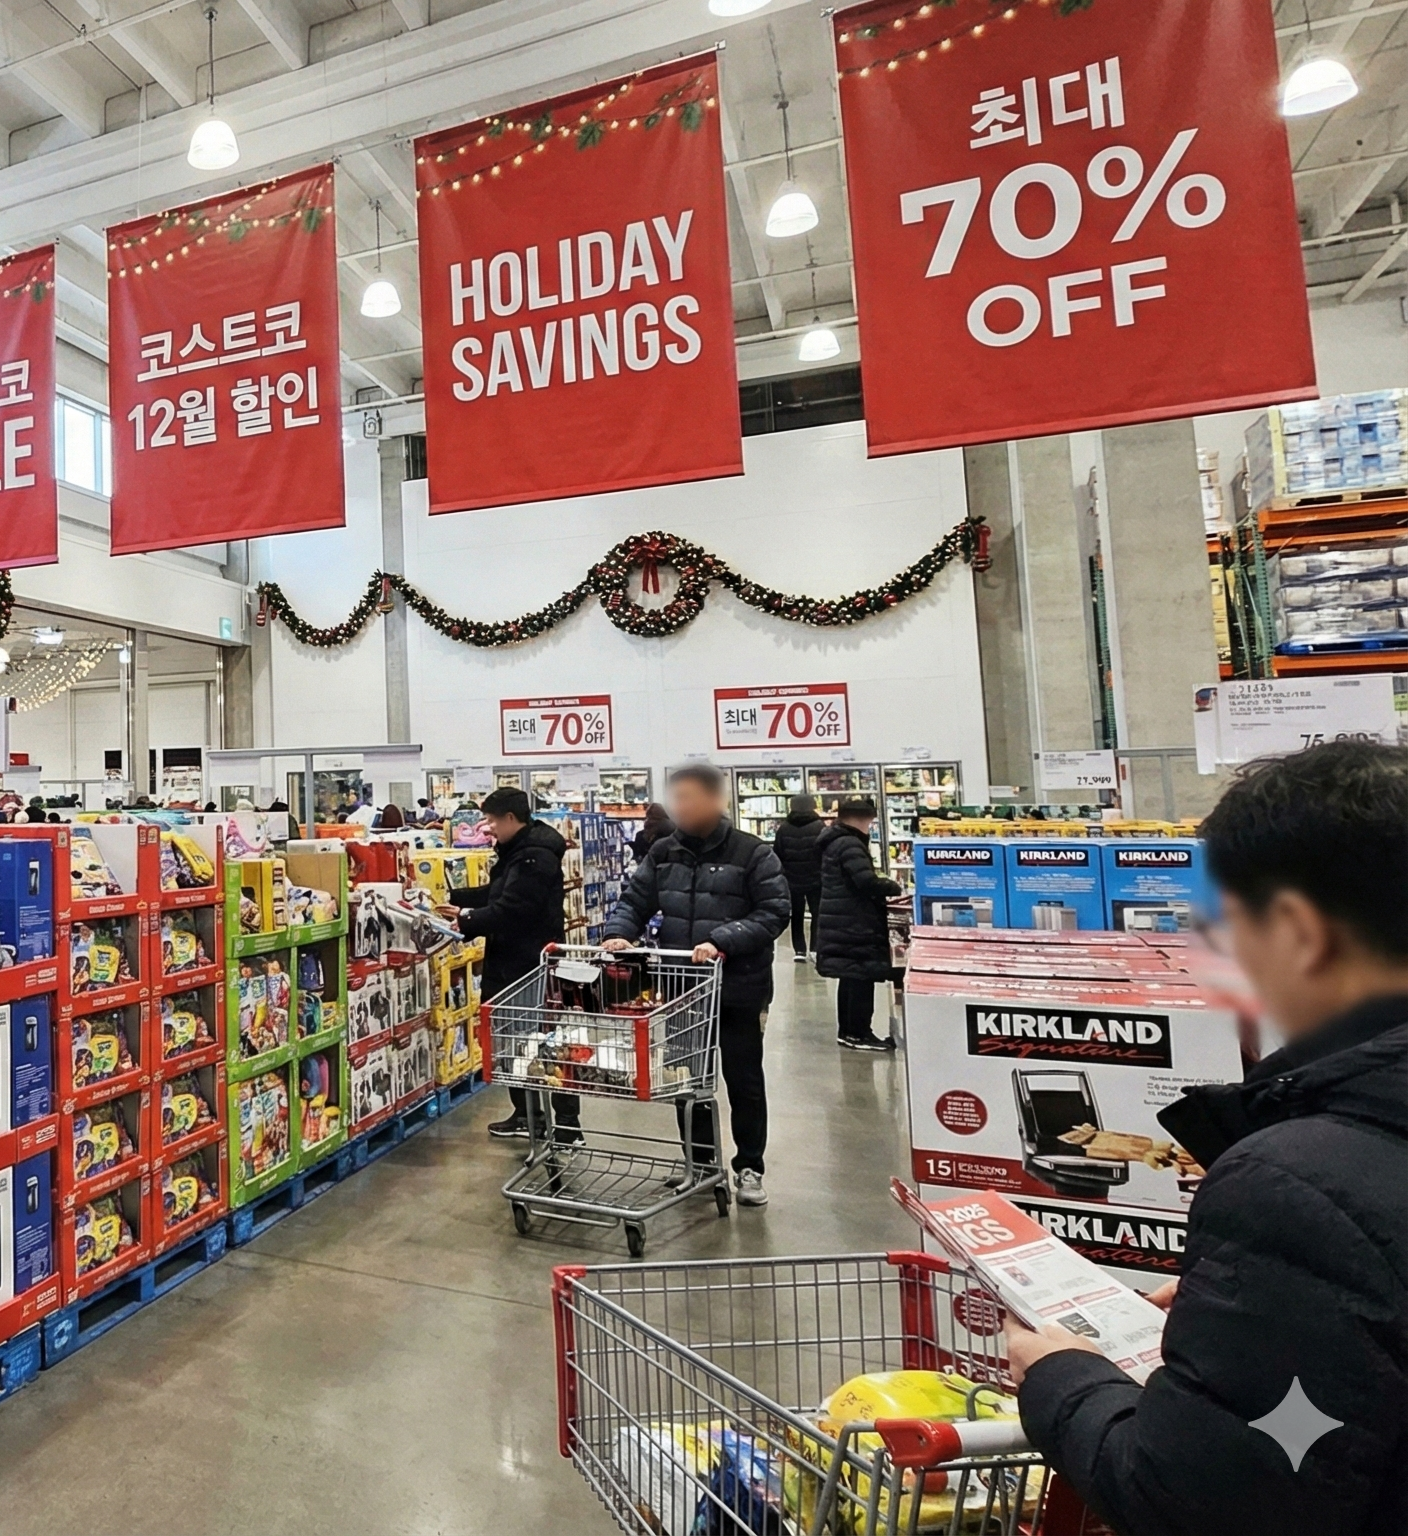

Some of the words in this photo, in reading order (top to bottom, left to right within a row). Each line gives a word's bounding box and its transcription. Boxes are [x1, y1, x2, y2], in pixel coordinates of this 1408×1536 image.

[969, 56, 1126, 149] 최대
[899, 128, 1226, 278] 70%
[449, 209, 694, 327] HOLIDAY
[966, 256, 1168, 347] OFF
[135, 301, 307, 383] 코스트코
[451, 294, 702, 402] SAVINGS
[127, 385, 217, 452] 12월
[230, 365, 320, 439] 할인
[585, 731, 605, 744] OFF
[724, 708, 757, 726] 최대
[815, 724, 841, 737] OFF
[1119, 851, 1188, 862] KIRKLAND
[976, 1012, 1162, 1045] KIRKLAND
[977, 1037, 1164, 1060] Signature
[925, 1159, 951, 1176] 15
[1021, 1209, 1187, 1252] IRKLAND
